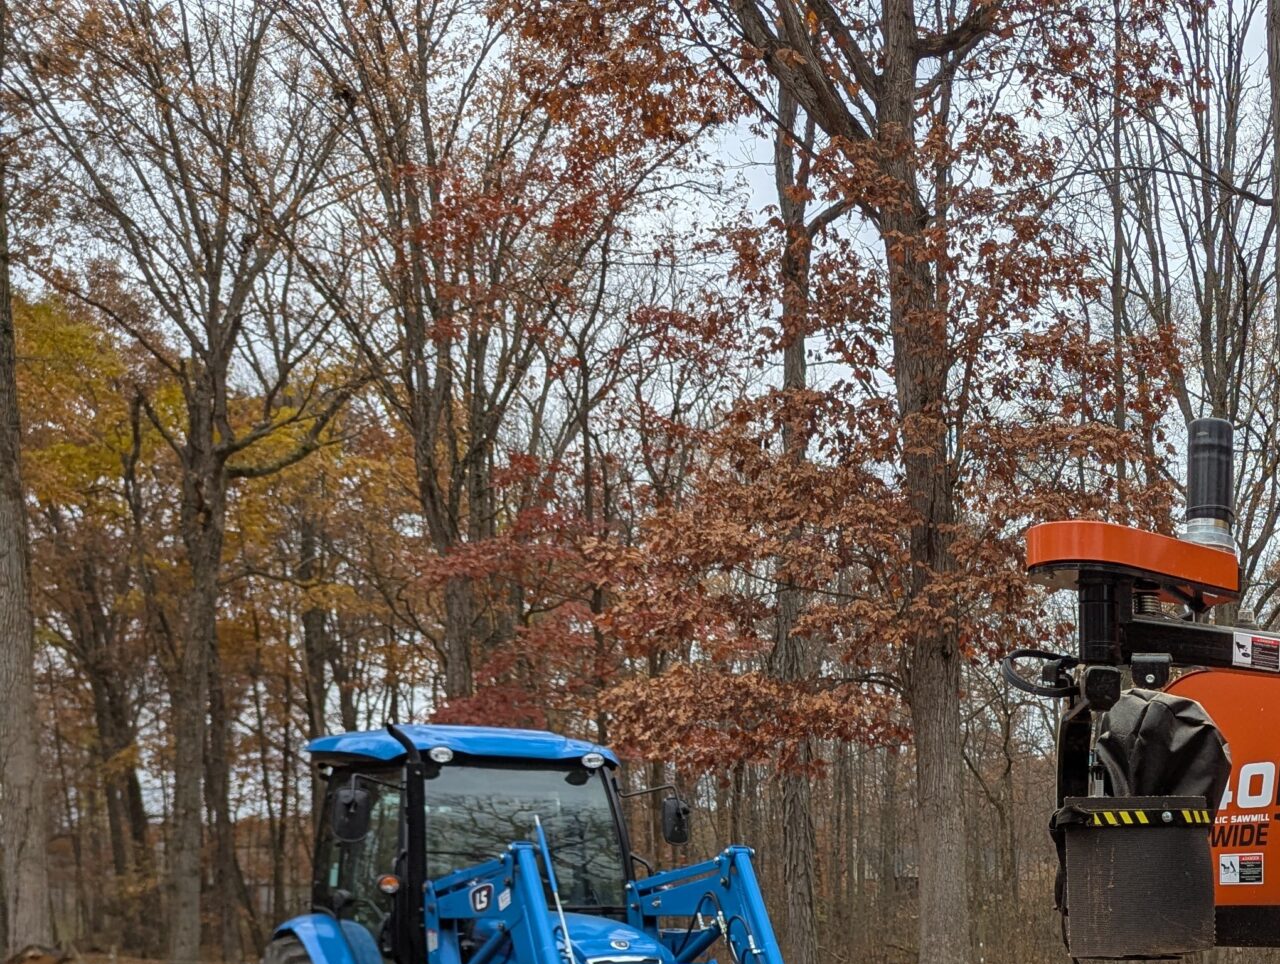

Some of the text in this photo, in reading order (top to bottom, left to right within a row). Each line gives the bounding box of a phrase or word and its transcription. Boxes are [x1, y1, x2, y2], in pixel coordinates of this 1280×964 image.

[1230, 813, 1270, 824] SAWMILL
[1210, 823, 1270, 848] WIDE
[474, 890, 488, 910] LS
